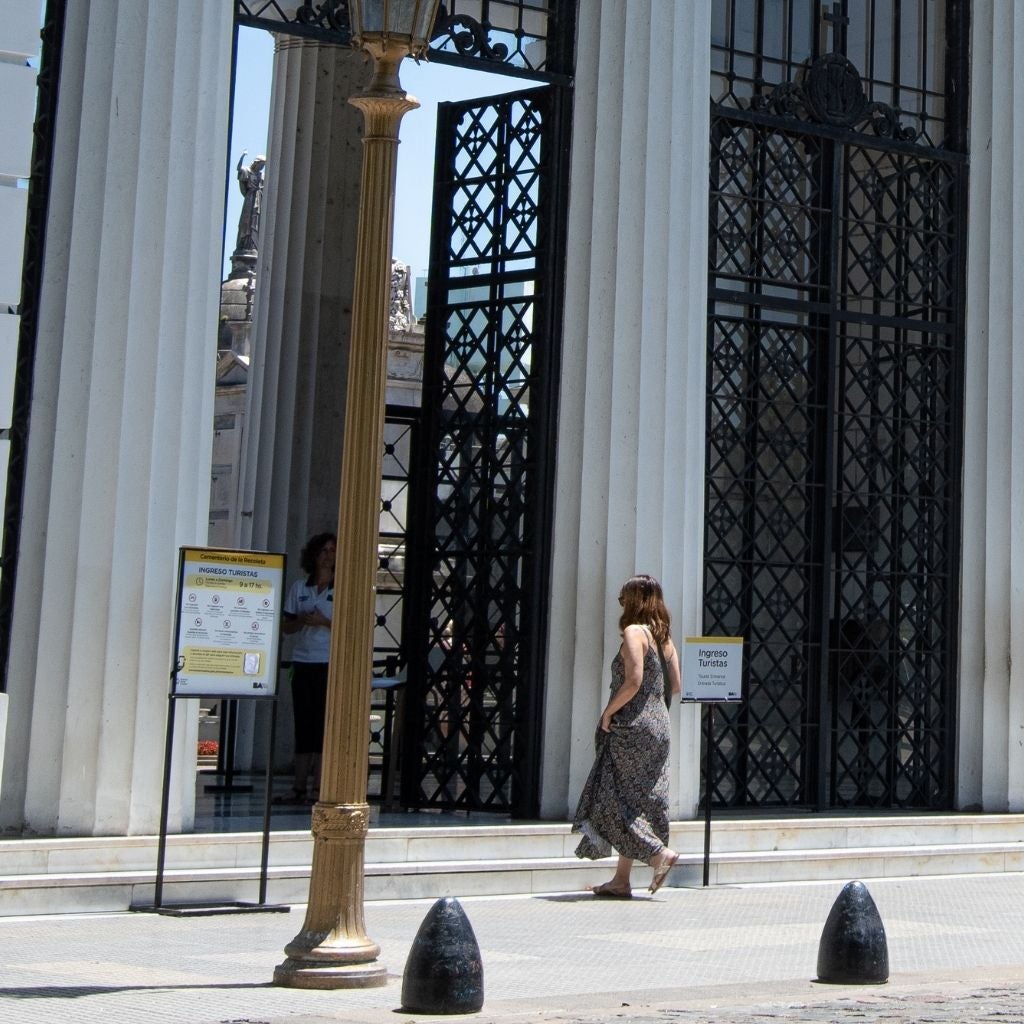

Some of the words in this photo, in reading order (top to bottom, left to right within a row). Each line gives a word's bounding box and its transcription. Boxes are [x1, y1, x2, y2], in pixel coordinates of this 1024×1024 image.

[198, 567, 227, 576] INGRESO
[229, 569, 259, 578] TURISTAS
[698, 649, 728, 658] Ingreso
[698, 659, 728, 667] Turistas
